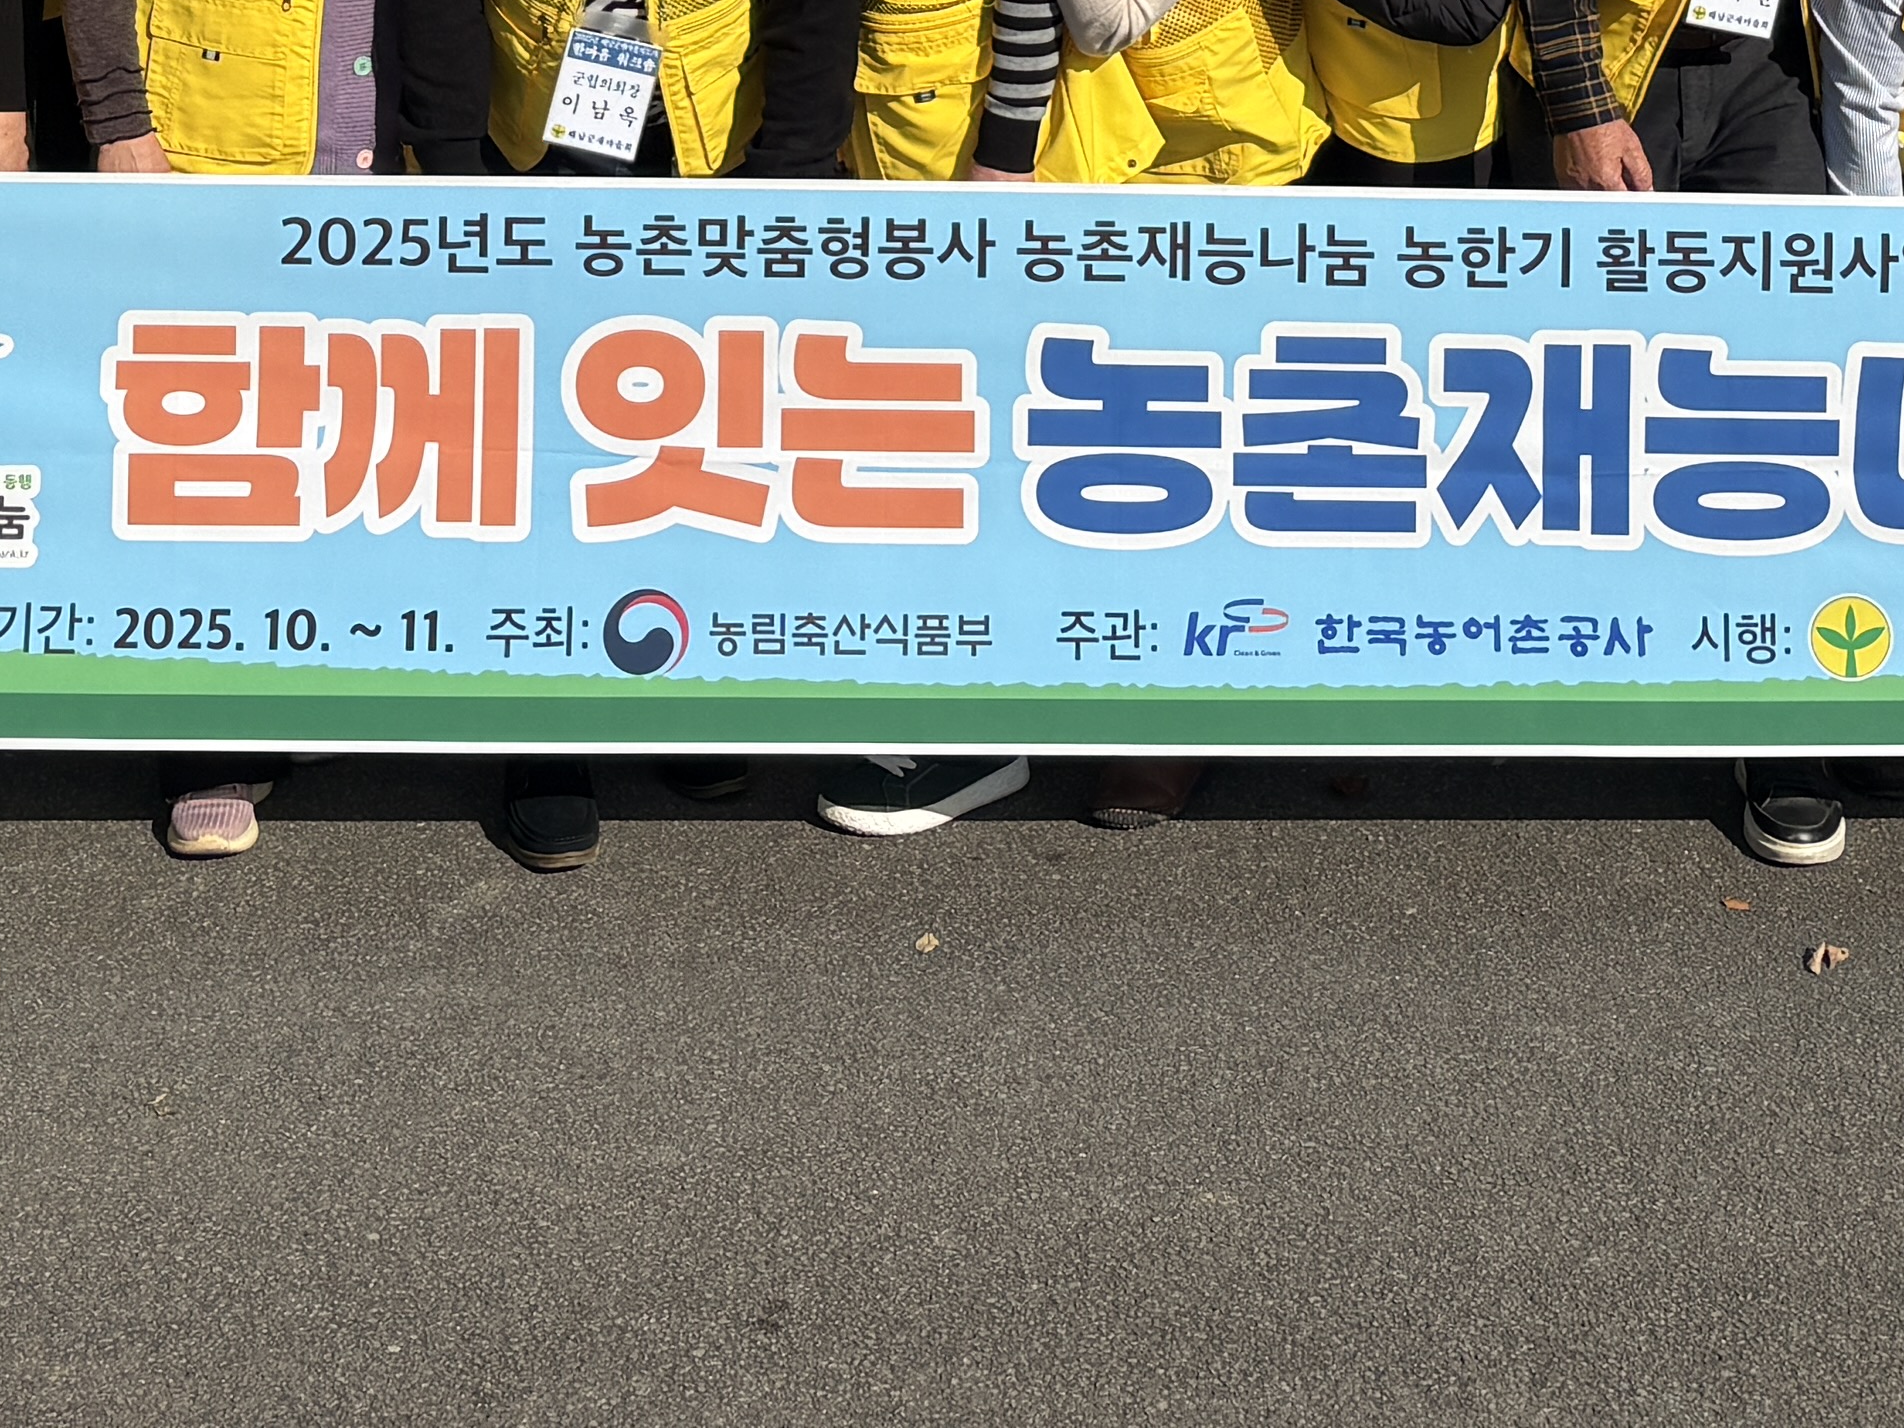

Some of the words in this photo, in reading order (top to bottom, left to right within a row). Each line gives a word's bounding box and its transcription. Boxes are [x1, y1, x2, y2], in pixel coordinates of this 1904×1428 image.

[280, 212, 553, 275] 2025년도
[575, 214, 996, 281] 농촌맞춤형봉사
[1016, 219, 1375, 287] 농촌재능나눔
[1397, 225, 1571, 289] 농한기
[114, 324, 522, 530] 함께
[574, 328, 978, 536] 잇는
[113, 607, 244, 651] 2025.
[264, 608, 330, 652] 10.
[401, 609, 454, 653] 11.
[485, 605, 588, 658] 주최:
[708, 611, 994, 658] 농림축산식품부
[1056, 609, 1159, 661] 주관:
[1315, 612, 1654, 658] 한국농어촌공사
[1691, 612, 1792, 665] 시행:
